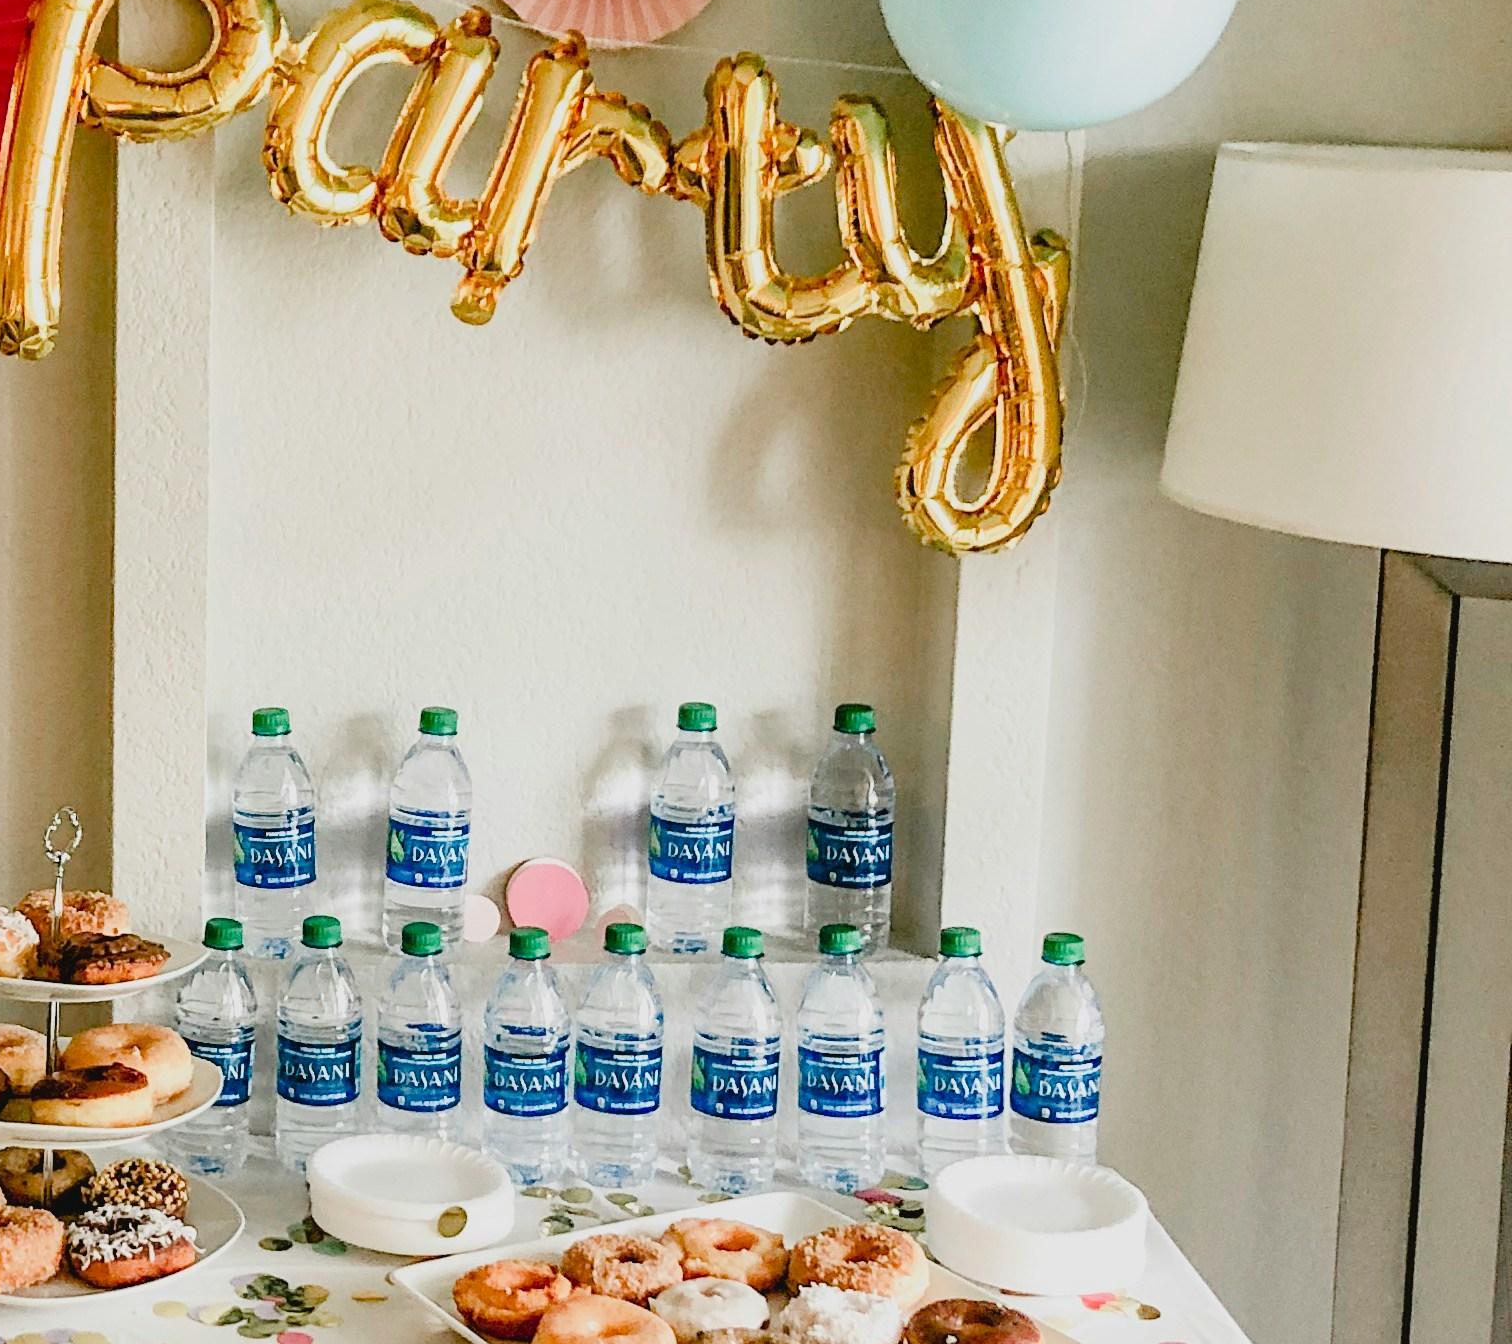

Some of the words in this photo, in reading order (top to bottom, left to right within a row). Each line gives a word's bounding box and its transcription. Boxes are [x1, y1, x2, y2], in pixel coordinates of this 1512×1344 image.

[250, 843, 312, 868] DASANI
[668, 840, 731, 864] DASANI
[826, 844, 890, 867] DASANI
[285, 1060, 350, 1084] DASANI
[394, 1066, 458, 1091] DASANI
[494, 1071, 560, 1095] DASANI
[595, 1068, 659, 1094] DASANI
[807, 1067, 875, 1096] DASANI
[712, 1074, 777, 1099] DASANI
[934, 1073, 1001, 1099] DASANI
